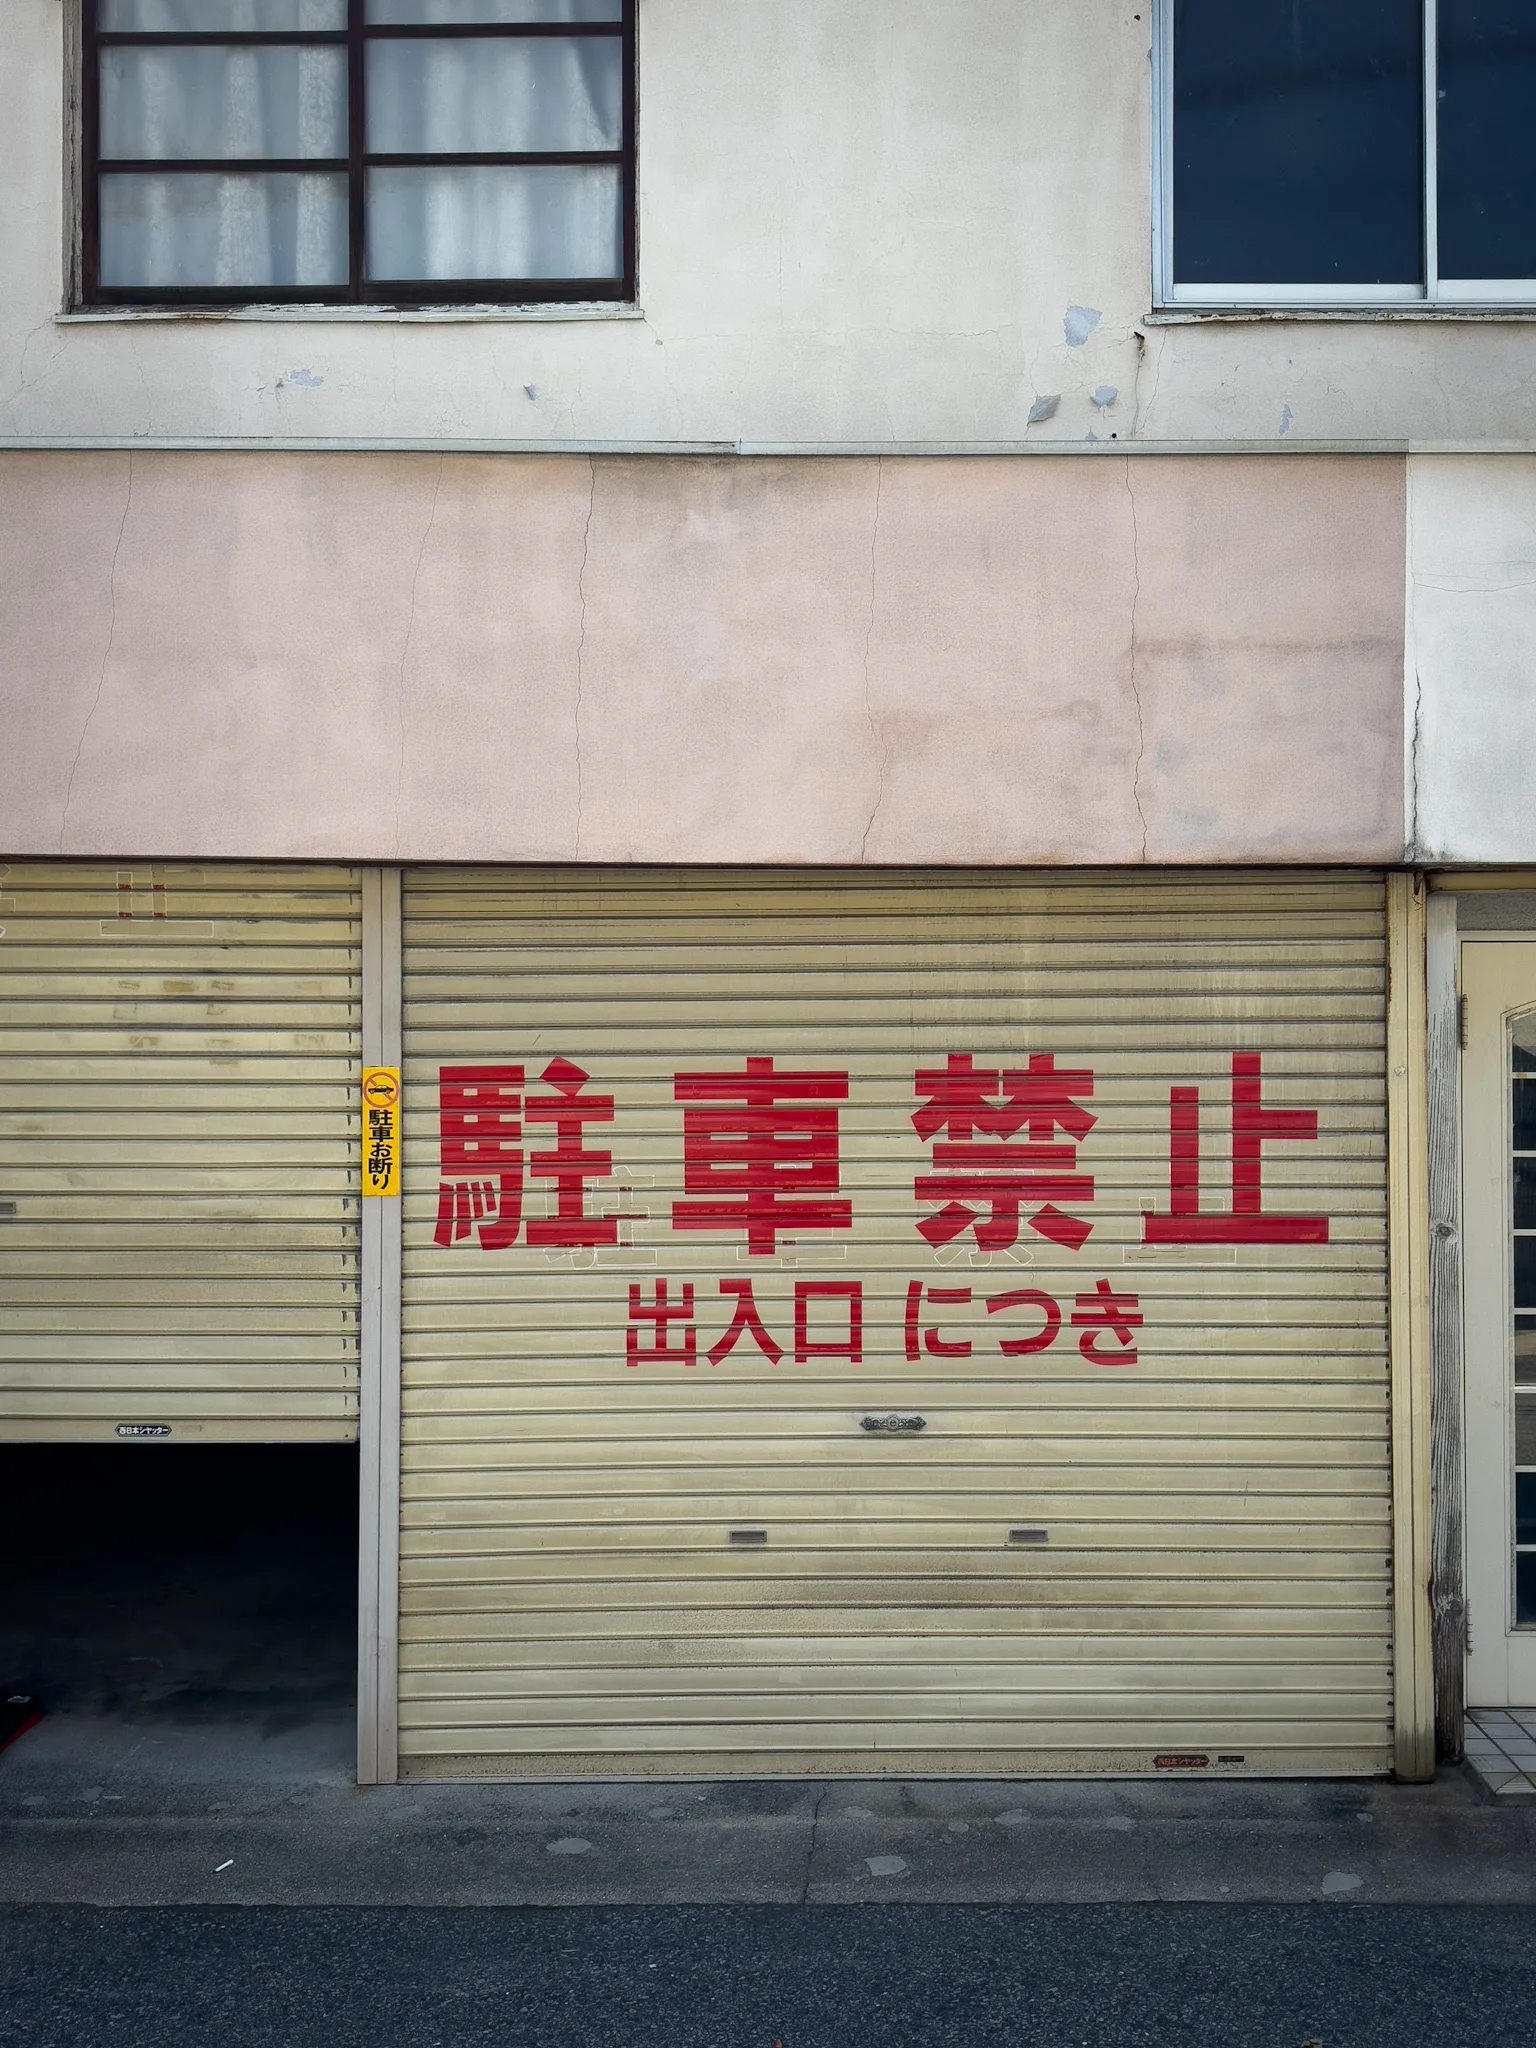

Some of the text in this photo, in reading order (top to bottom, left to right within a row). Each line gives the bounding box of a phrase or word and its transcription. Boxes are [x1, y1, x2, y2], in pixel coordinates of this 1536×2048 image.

[368, 1109, 394, 1190] 駐車お断り
[433, 1053, 1329, 1252] 駐車禁止
[626, 1279, 1143, 1367] 出入口につき
